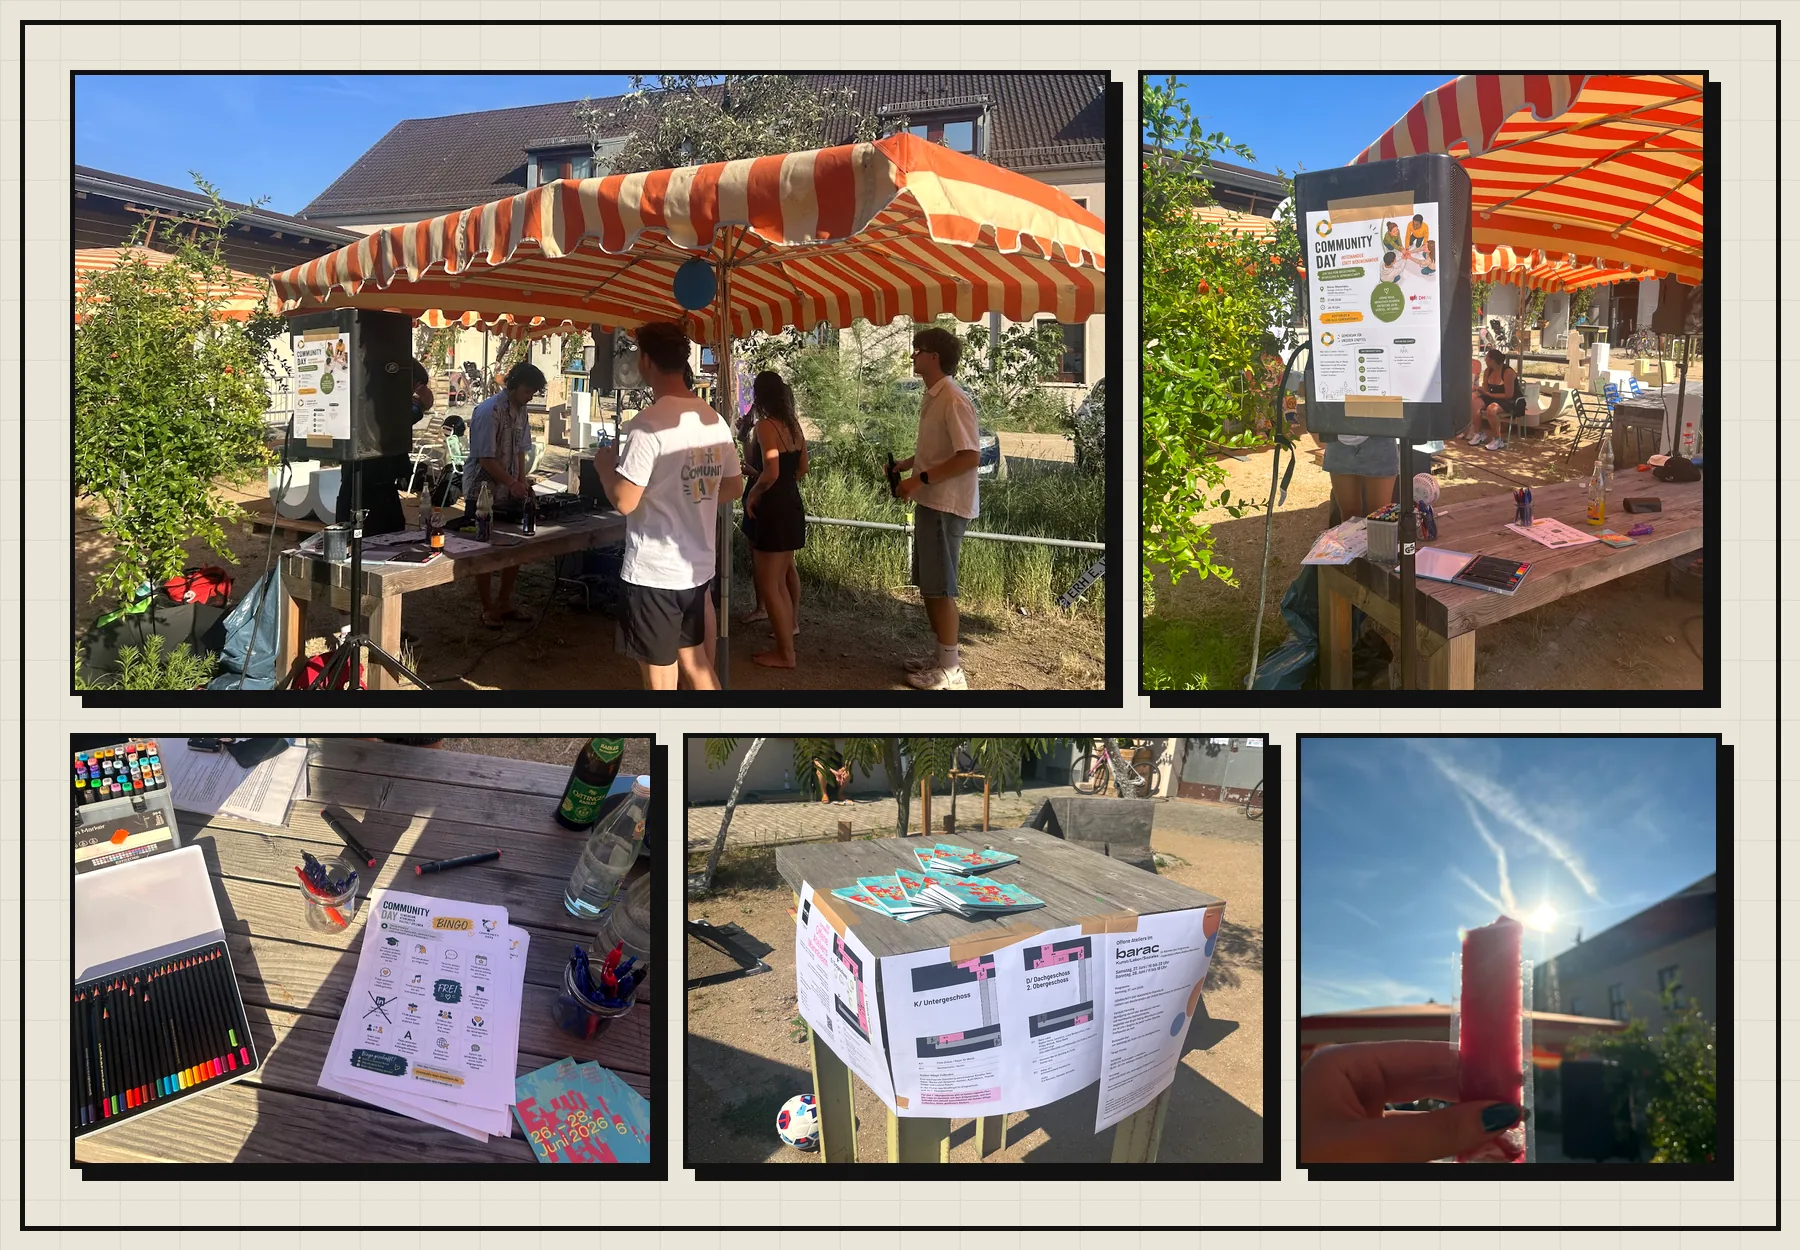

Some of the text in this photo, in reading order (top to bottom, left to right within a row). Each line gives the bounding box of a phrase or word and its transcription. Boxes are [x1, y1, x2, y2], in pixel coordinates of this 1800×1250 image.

[1315, 235, 1373, 254] COMMUNITY
[1316, 253, 1336, 269] DAY
[297, 349, 322, 357] COMMUNITY
[81, 824, 105, 834] Marker
[381, 910, 398, 920] DAY
[383, 901, 430, 917] COMMUNITY
[436, 919, 468, 930] BINGO
[1116, 944, 1159, 959] barac
[1034, 970, 1070, 982] Dachgeschoss
[438, 984, 458, 993] FREI
[1033, 977, 1069, 989] Obergeschoss
[924, 992, 971, 1006] Untergeschoss
[404, 1030, 412, 1040] A
[531, 1126, 556, 1144] 26.
[568, 1110, 592, 1127] 28.
[540, 1117, 608, 1156] Juni 2026
